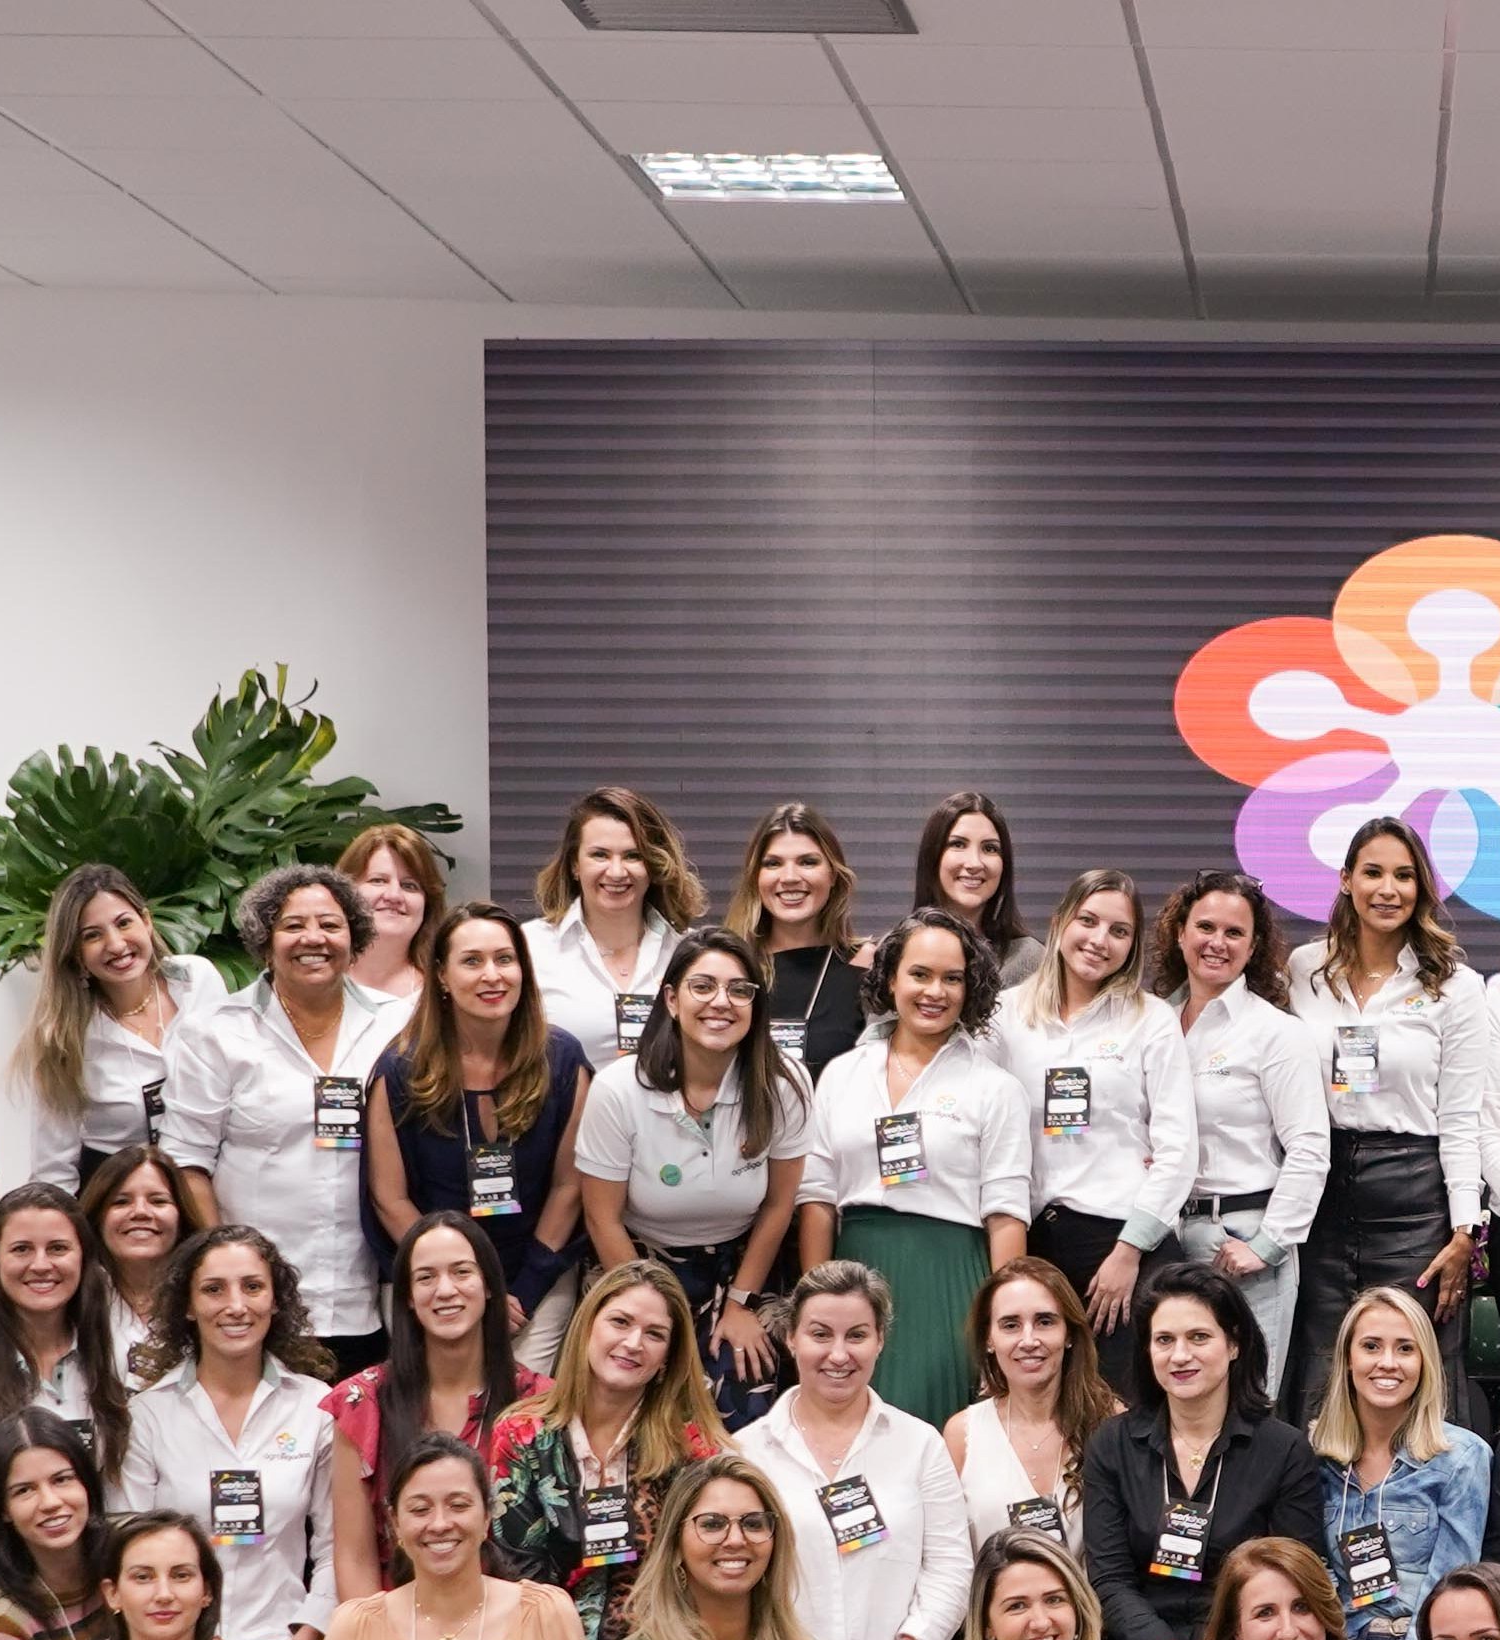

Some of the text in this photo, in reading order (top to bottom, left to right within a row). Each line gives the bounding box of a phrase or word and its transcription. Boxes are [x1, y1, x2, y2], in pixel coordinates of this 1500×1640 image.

[322, 1087, 359, 1098] workshop
[219, 1481, 259, 1490] workshop
[828, 1486, 866, 1502] workshop
[587, 1498, 626, 1509] workshop
[1018, 1507, 1056, 1520] workshop
[1170, 1512, 1208, 1526] workshop
[1347, 1536, 1384, 1552] workshop
